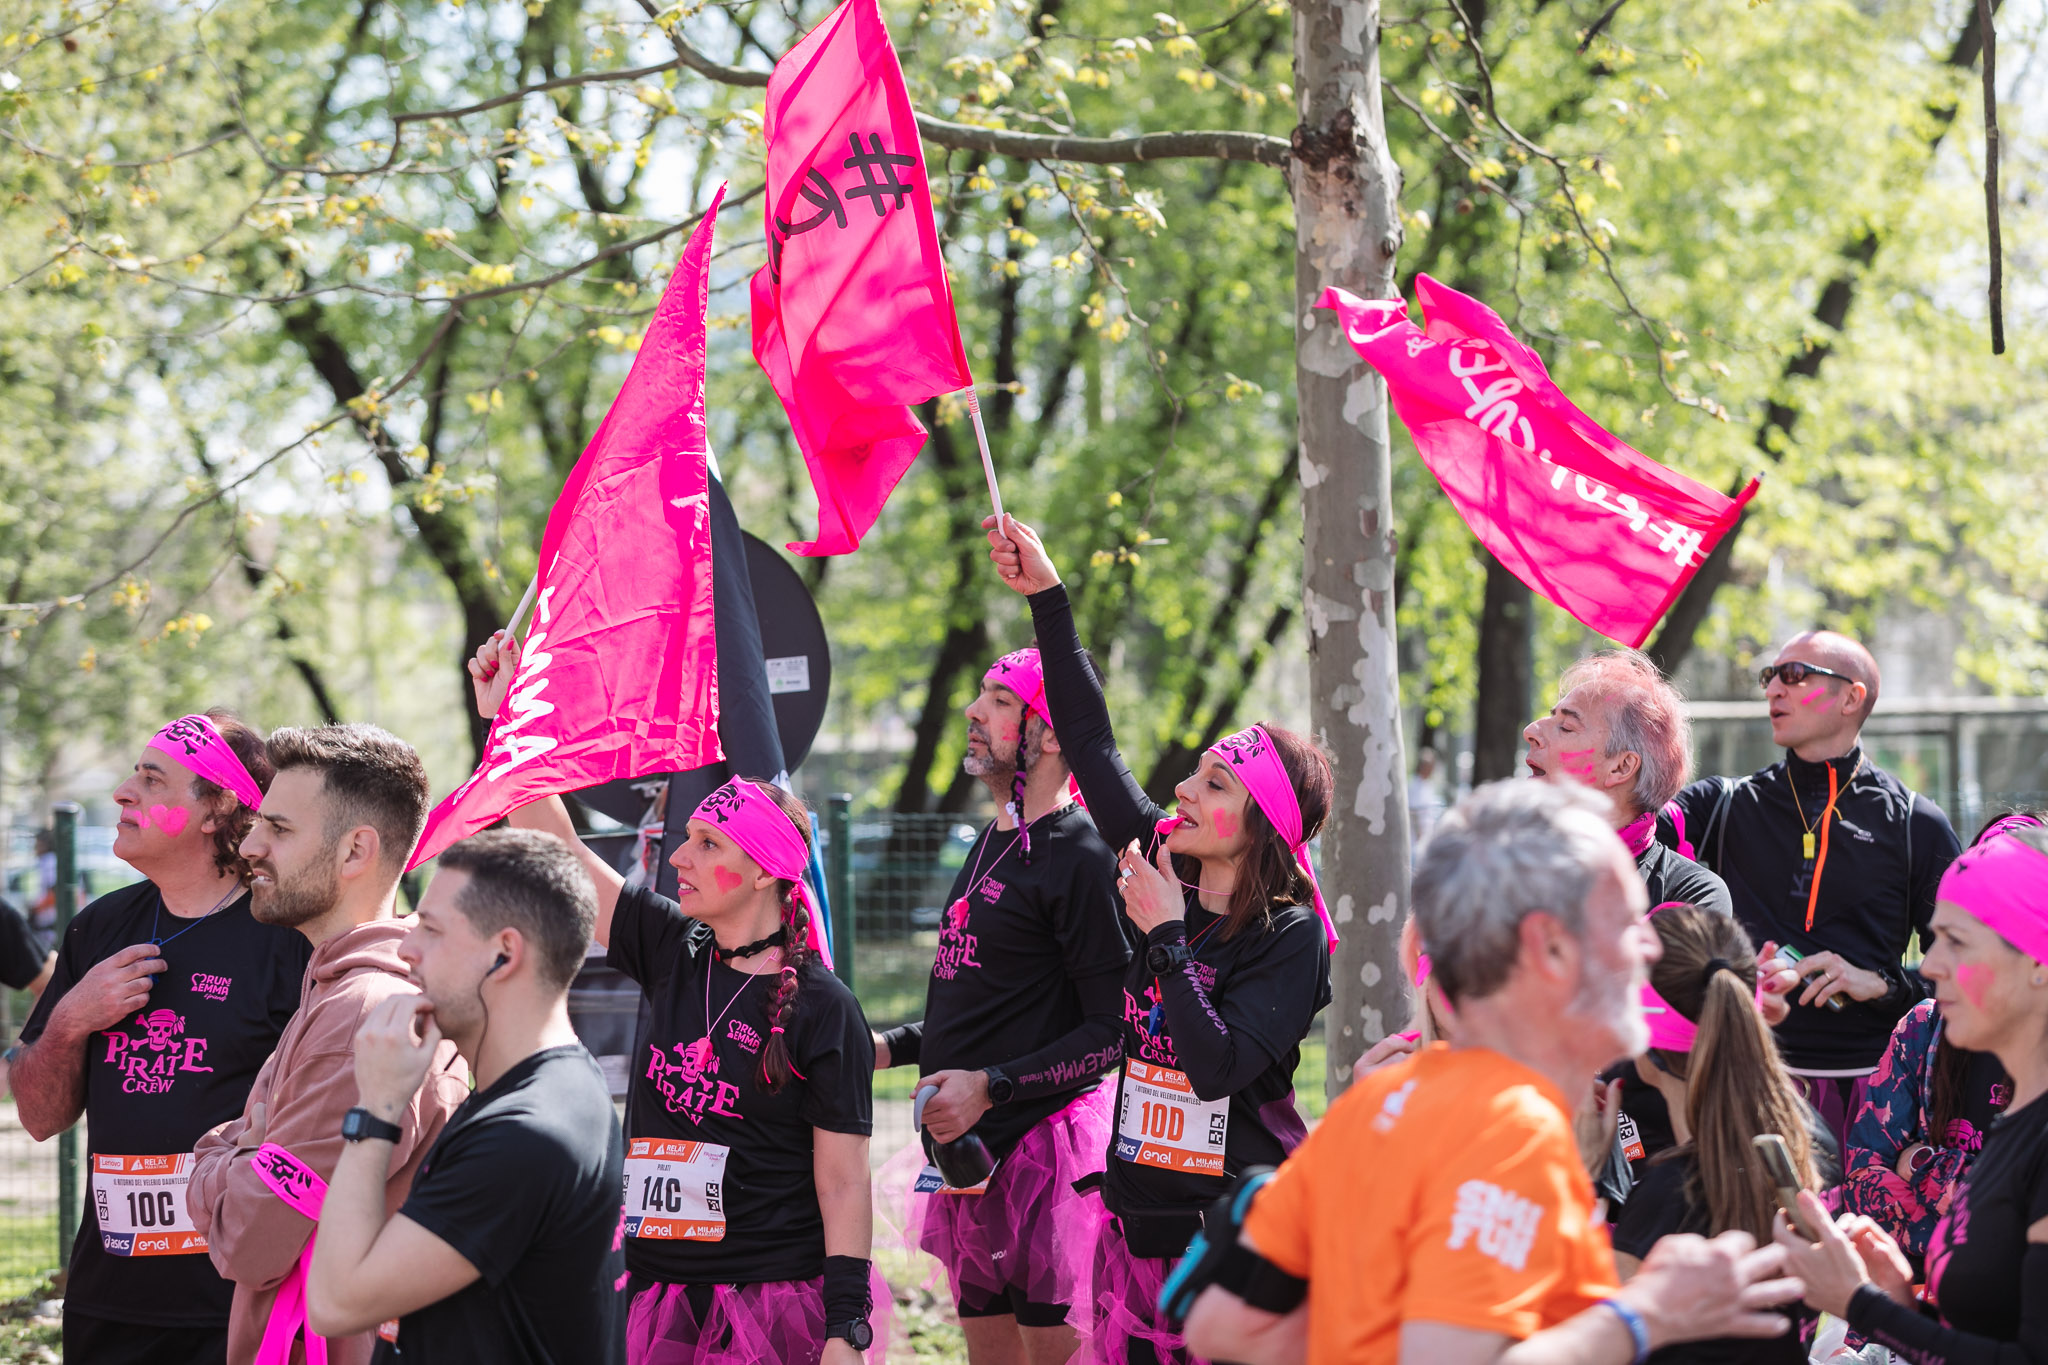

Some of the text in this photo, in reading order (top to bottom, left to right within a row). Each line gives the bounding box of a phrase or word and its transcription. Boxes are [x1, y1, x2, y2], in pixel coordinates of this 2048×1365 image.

[934, 964, 957, 980] CREW
[206, 975, 229, 986] RUN
[198, 983, 229, 995] EMMA
[734, 1031, 760, 1048] EMMA
[101, 1031, 213, 1082] PIRATE
[646, 1044, 744, 1119] PIRATE
[1164, 1071, 1187, 1082] RELAY
[122, 1076, 175, 1094] CREW
[1141, 1101, 1185, 1142] 10D
[666, 1144, 686, 1152] RELAY
[144, 1158, 168, 1166] RELAY
[1143, 1150, 1172, 1165] enel
[1195, 1157, 1223, 1167] MILANO
[642, 1176, 682, 1212] 14C
[127, 1191, 175, 1227] 10C
[644, 1224, 672, 1237] enel
[110, 1237, 170, 1250] asics enel
